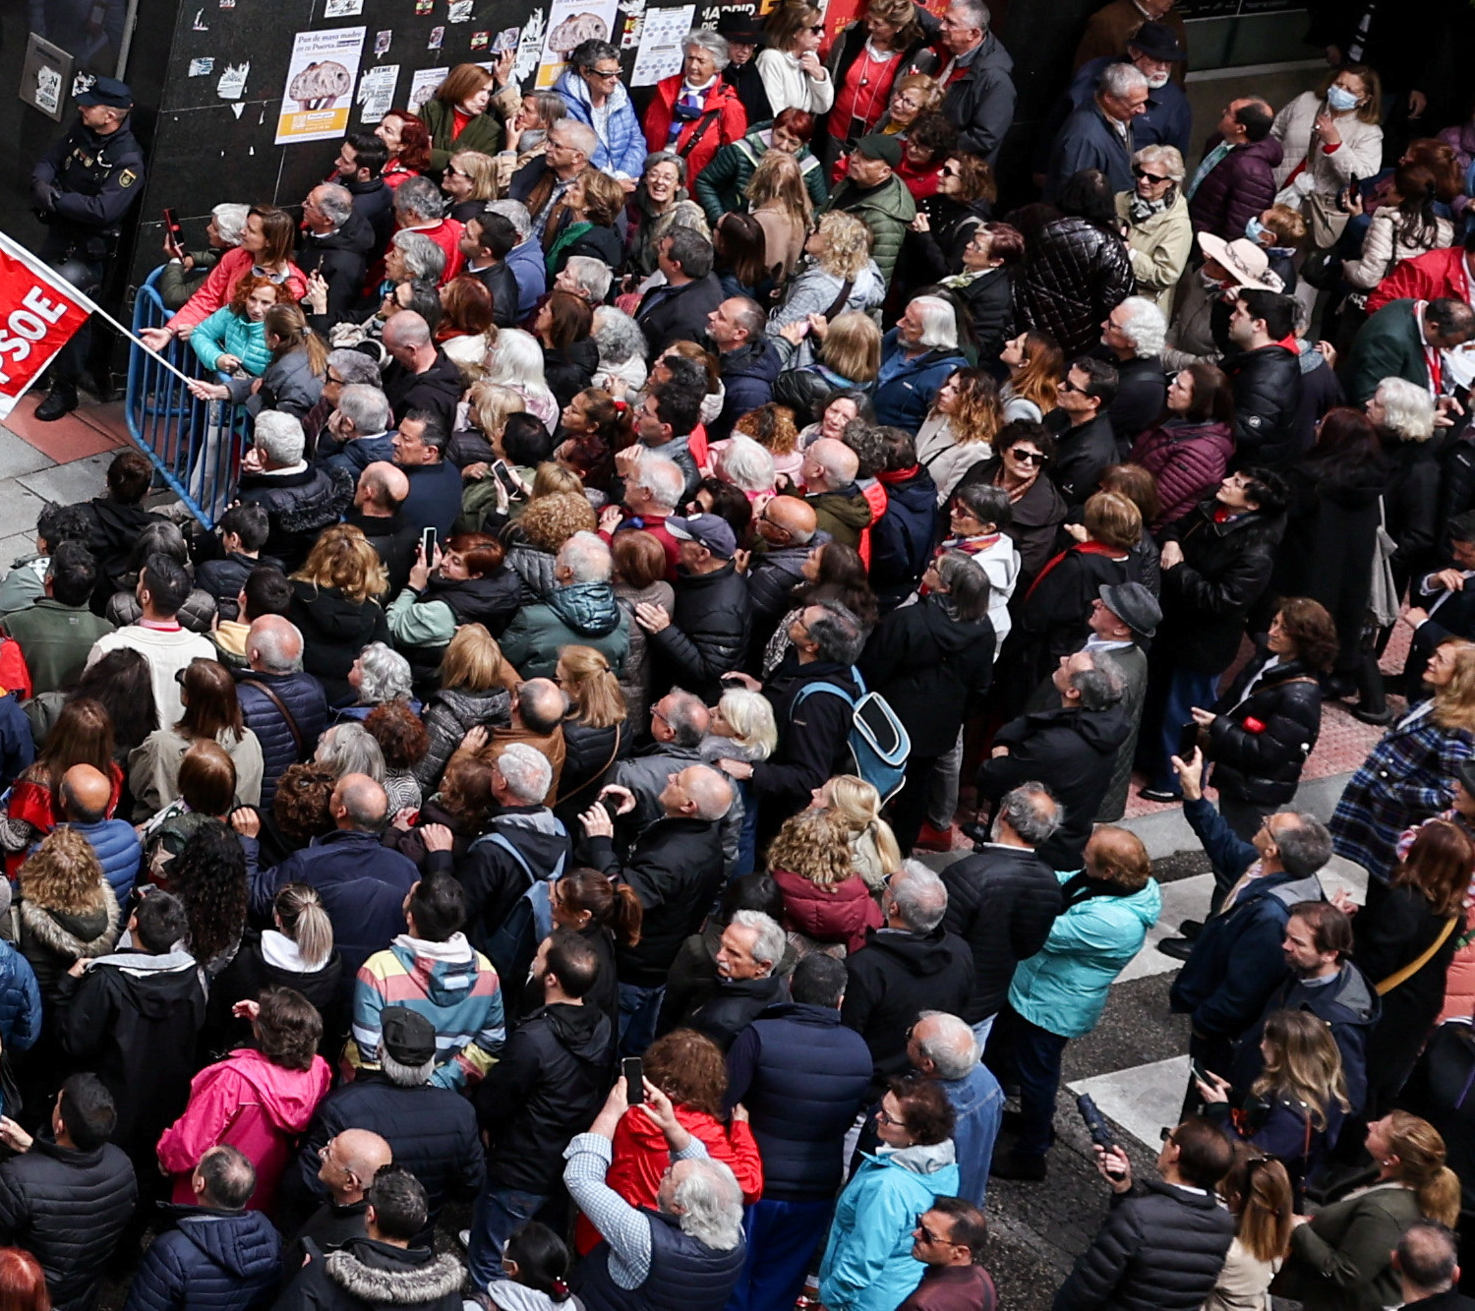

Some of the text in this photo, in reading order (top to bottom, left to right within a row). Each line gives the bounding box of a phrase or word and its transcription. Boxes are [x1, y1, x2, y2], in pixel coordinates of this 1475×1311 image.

[298, 34, 312, 44] Pan
[322, 33, 340, 42] masa
[340, 30, 363, 39] madre
